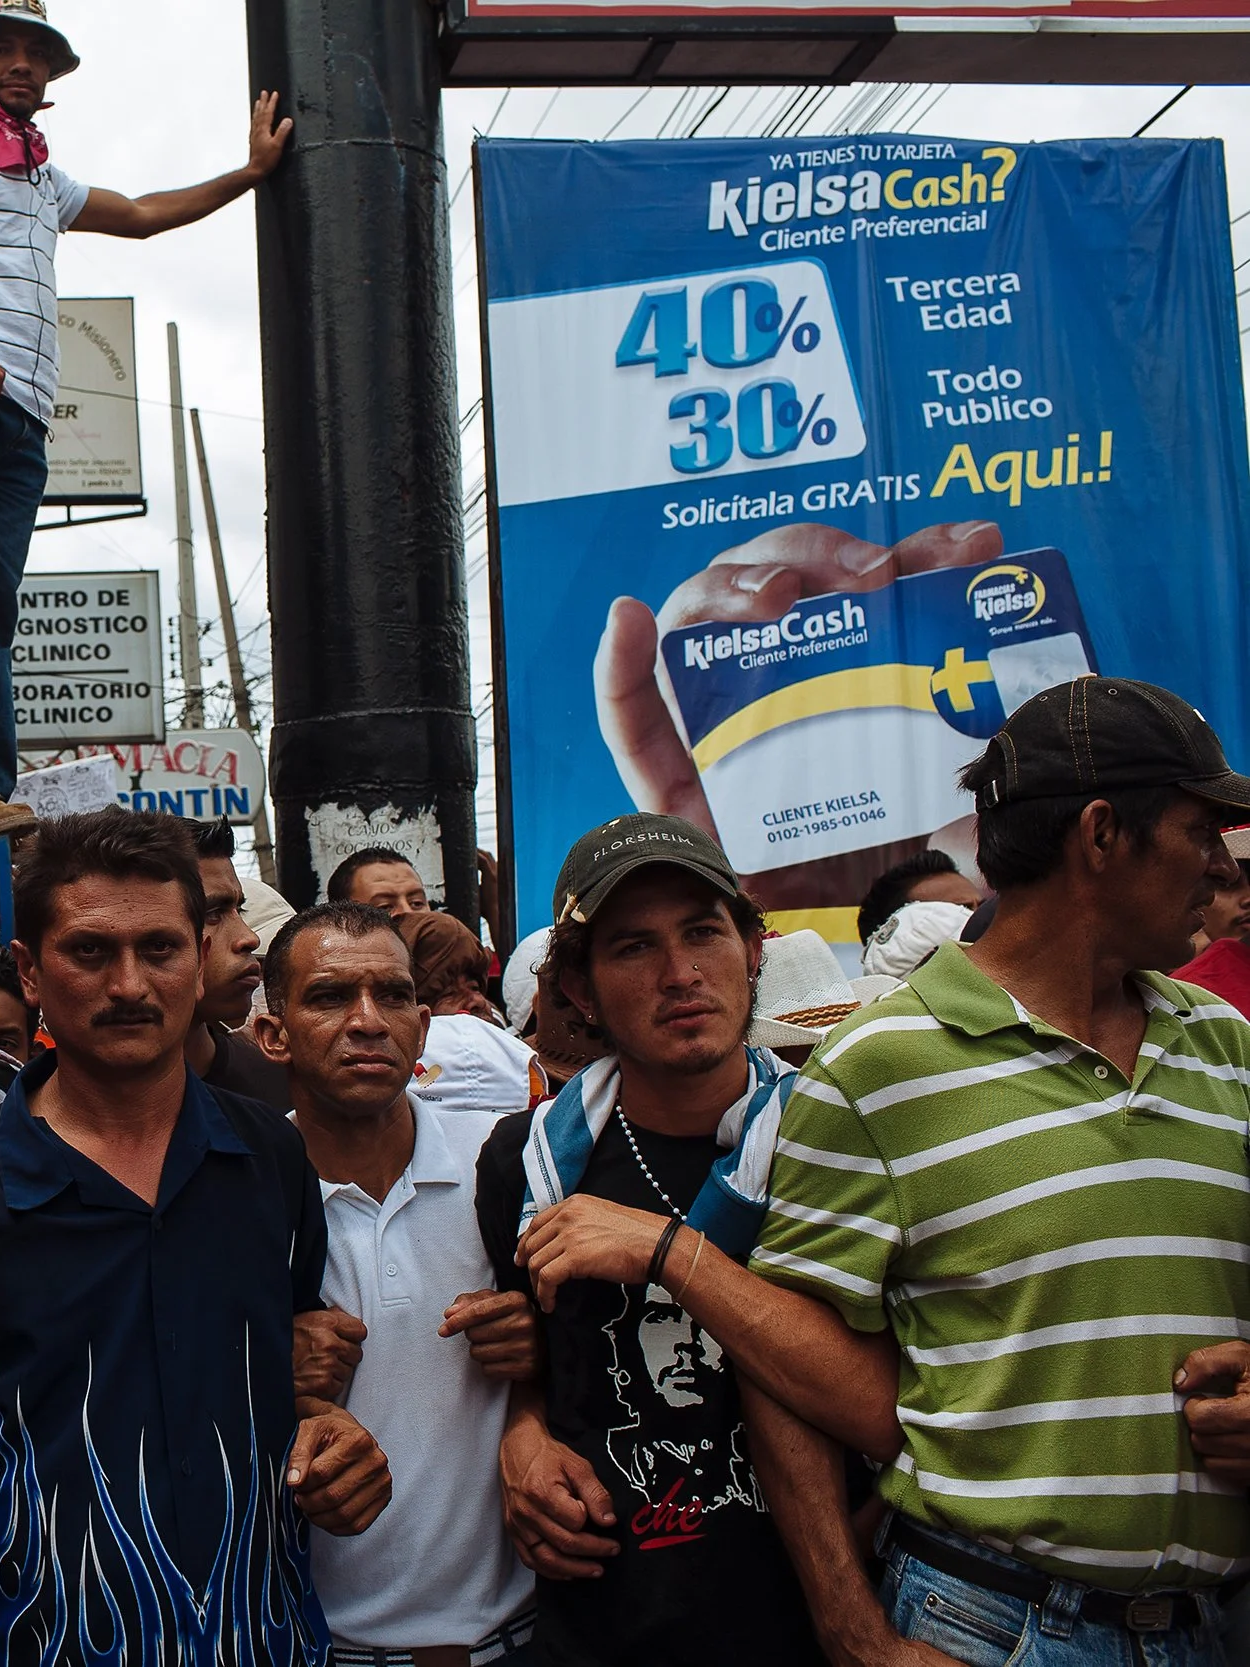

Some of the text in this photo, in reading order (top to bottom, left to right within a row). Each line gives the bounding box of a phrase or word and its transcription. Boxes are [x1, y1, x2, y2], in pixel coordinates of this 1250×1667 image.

[769, 143, 956, 171] YA TIENES TU TARJETA
[759, 209, 988, 252] Cliente Preferencial
[885, 272, 1021, 302] Tercera
[616, 275, 821, 378] 40%
[920, 298, 1012, 331] Edad
[927, 365, 1022, 395] Todo
[668, 376, 837, 474] 30%
[922, 395, 1053, 428] Publico
[662, 489, 794, 530] Solicítala
[801, 473, 921, 511] GRATIS
[20, 589, 130, 608] NTRO DE
[16, 615, 148, 636] GNOSTICO
[11, 643, 111, 663] CLINICO
[739, 629, 868, 670] Cliente Preferencial
[12, 682, 151, 701] BORATORIO
[14, 706, 113, 725] CLINICO
[762, 790, 881, 826] CLIENTE KIELSA
[767, 807, 887, 843] 0102-1985-01046
[593, 832, 694, 861] FLORSHEIM
[630, 1477, 704, 1536] che
